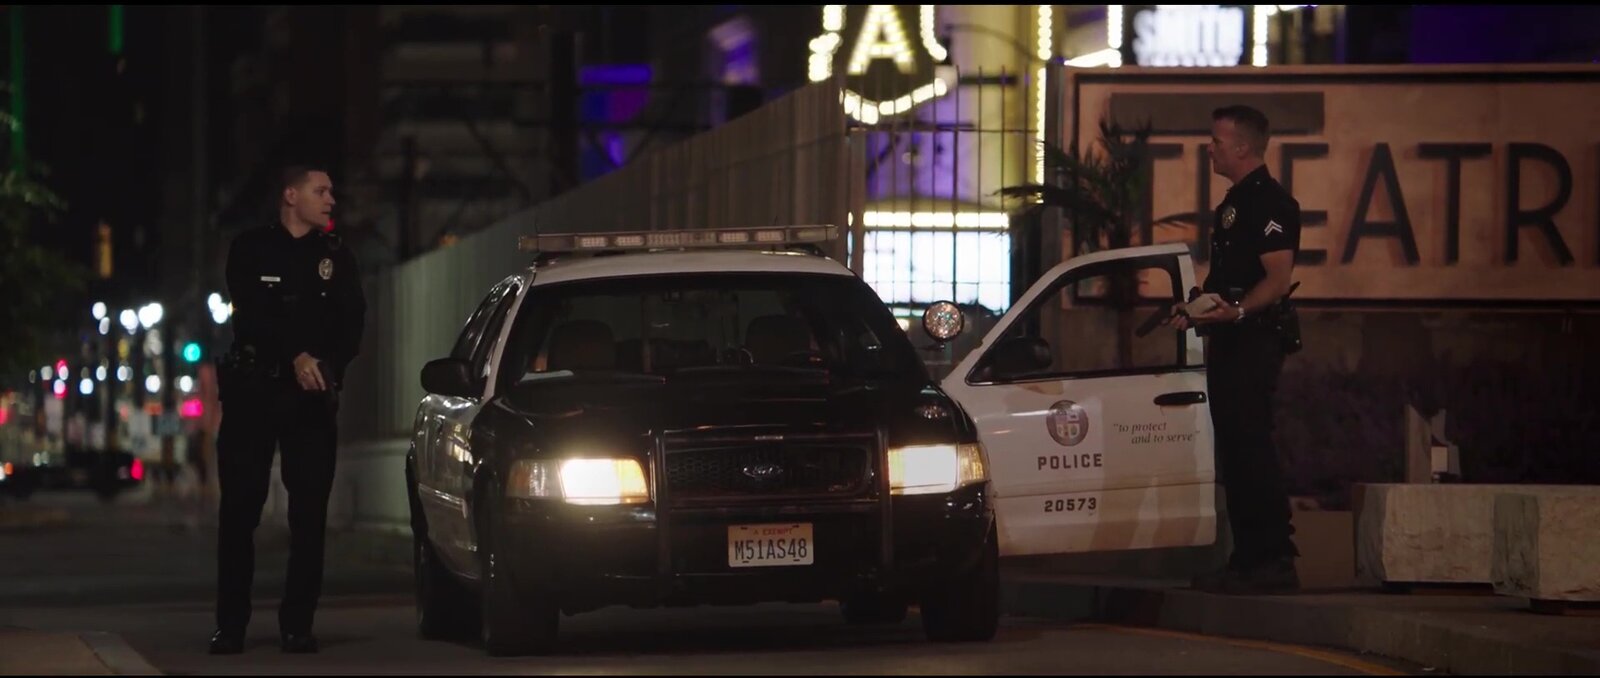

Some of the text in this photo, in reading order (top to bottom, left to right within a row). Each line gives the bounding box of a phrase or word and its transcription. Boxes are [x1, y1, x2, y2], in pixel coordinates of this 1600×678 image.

[1131, 422, 1167, 435] protect
[1131, 432, 1151, 444] and
[1153, 434, 1164, 443] to
[1037, 453, 1103, 471] POLICE
[1043, 497, 1097, 513] 20573
[734, 538, 807, 561] M51AS48
